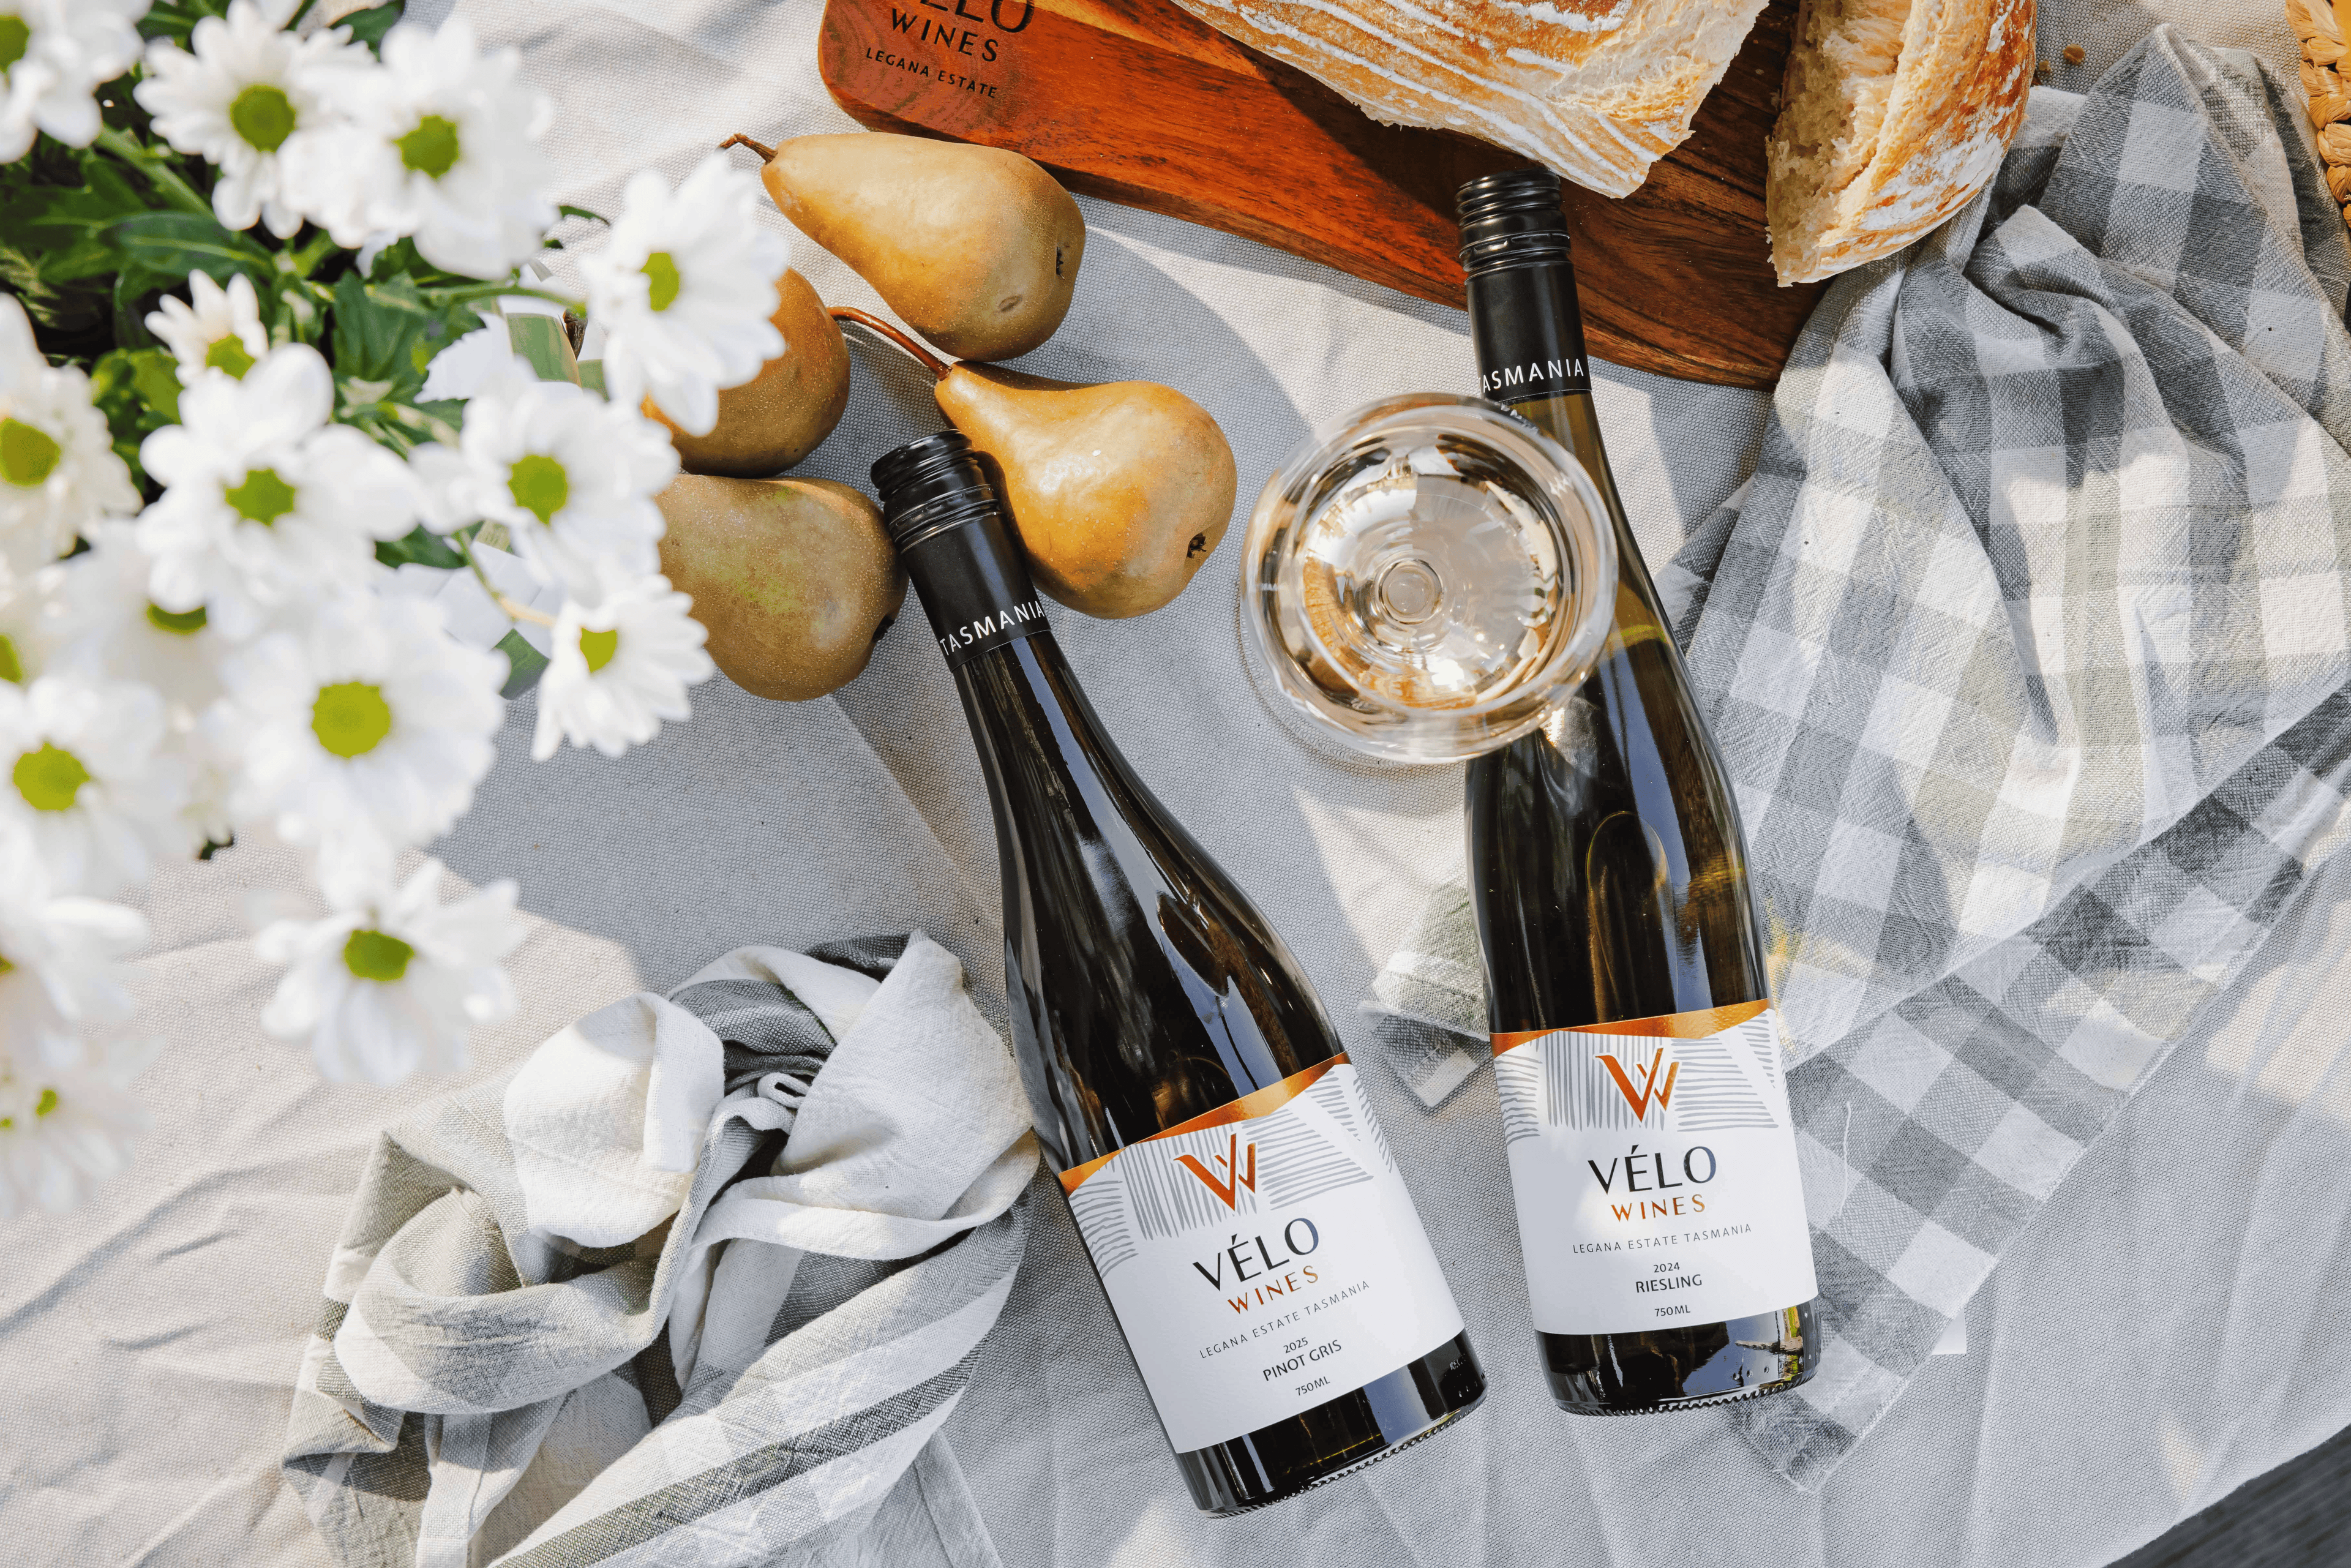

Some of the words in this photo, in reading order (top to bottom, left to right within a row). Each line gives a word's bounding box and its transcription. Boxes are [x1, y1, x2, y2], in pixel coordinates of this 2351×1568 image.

[891, 8, 999, 62] WINES
[866, 47, 929, 77] LEGANA
[937, 70, 997, 99] ESTATE
[939, 600, 1045, 656] TASMANIA
[1587, 1144, 1717, 1195] VÉLO
[1610, 1193, 1705, 1223] WINES
[1192, 1217, 1319, 1292] VÉLO
[1572, 1242, 1622, 1254] LEGANA
[1627, 1235, 1679, 1250] ESTATE
[1684, 1223, 1752, 1243] TASMANIA
[1635, 1274, 1703, 1293] RIESLING
[1652, 1262, 1681, 1274] 2024
[1227, 1265, 1319, 1315] WINES
[1654, 1304, 1692, 1317] 750ML
[1199, 1334, 1248, 1359] LEGANA
[1252, 1311, 1300, 1338] ESTATE
[1303, 1280, 1370, 1316] TASMANIA
[1262, 1354, 1305, 1382] PINOT
[1308, 1339, 1342, 1362] GRIS
[1283, 1337, 1308, 1354] 2025
[1295, 1376, 1331, 1396] 750ML
